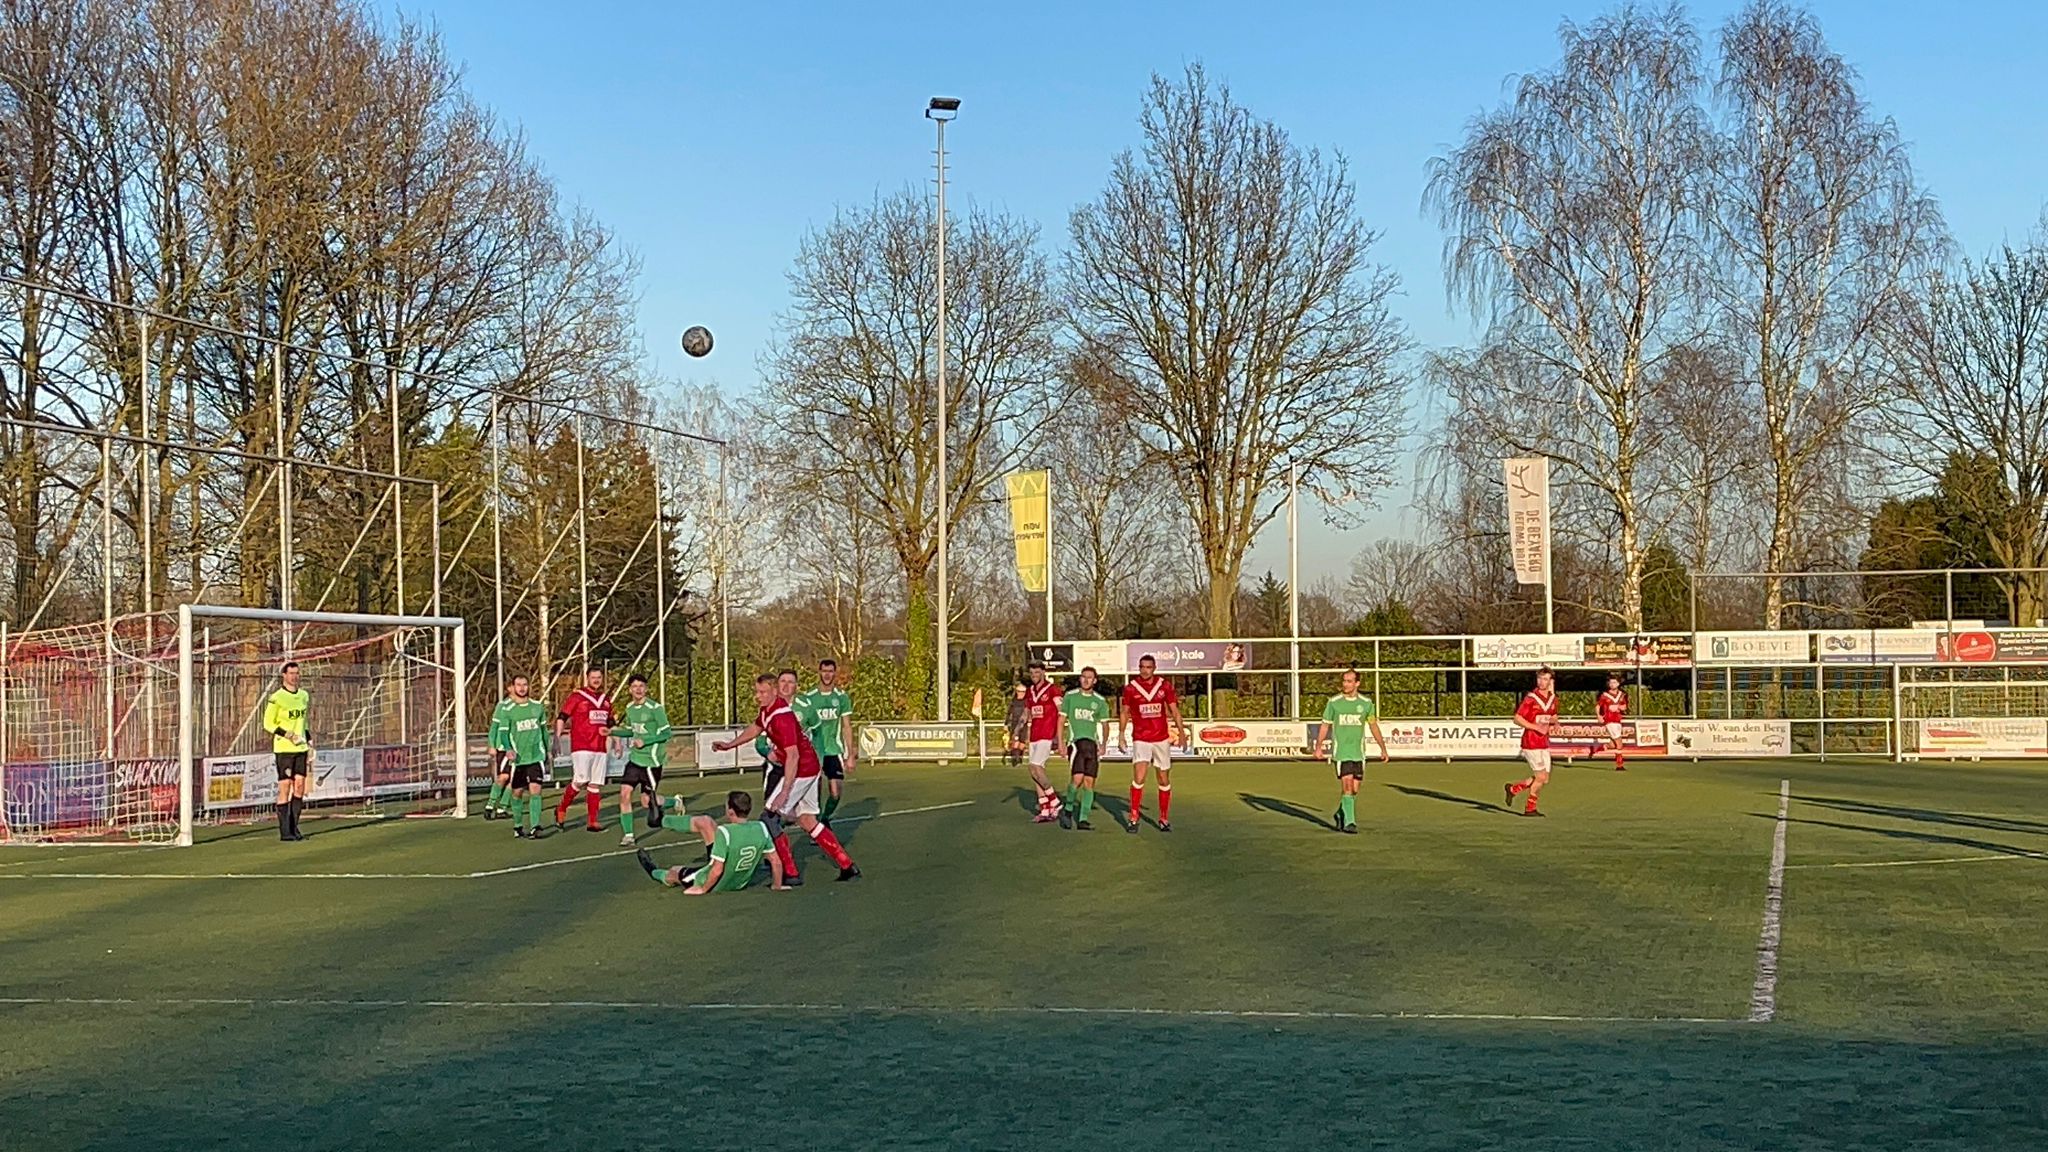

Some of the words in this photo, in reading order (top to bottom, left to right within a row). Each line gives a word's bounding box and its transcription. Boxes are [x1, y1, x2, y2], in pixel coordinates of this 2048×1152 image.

[1731, 641, 1792, 651] BOEVE
[1671, 723, 1705, 733] Slagerij
[1743, 723, 1760, 732] den
[1764, 723, 1786, 733] Berg
[1712, 734, 1748, 743] Hierden
[735, 846, 756, 871] 2
